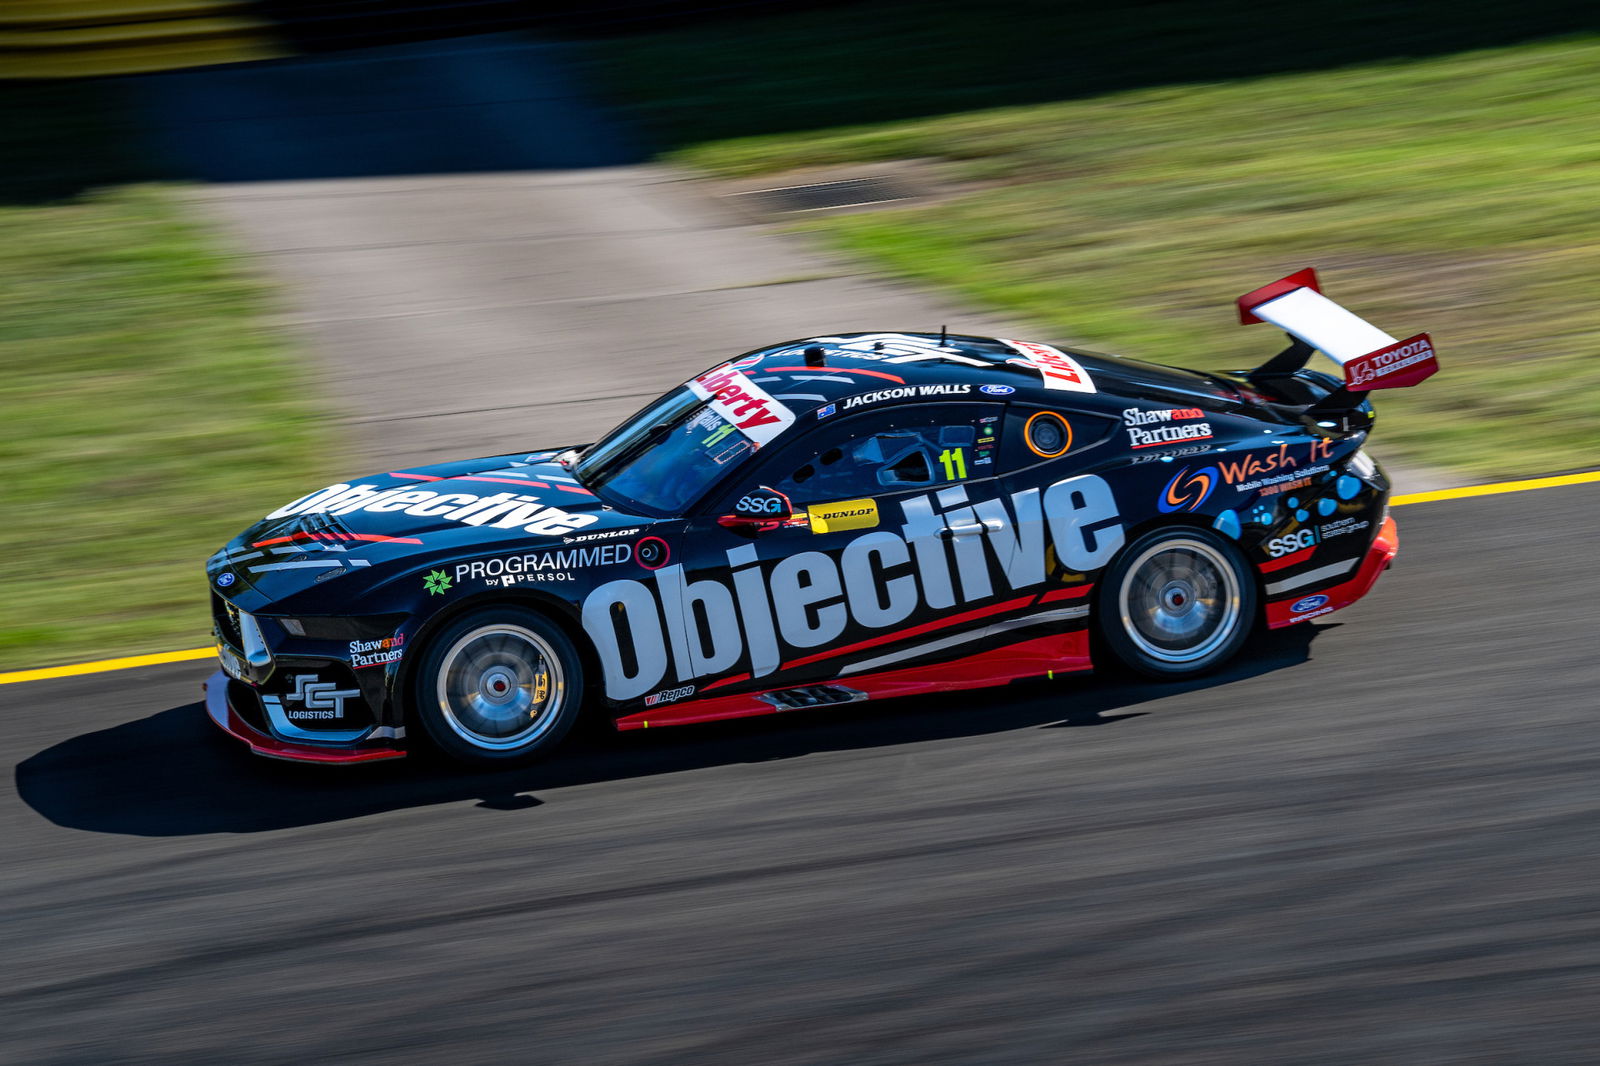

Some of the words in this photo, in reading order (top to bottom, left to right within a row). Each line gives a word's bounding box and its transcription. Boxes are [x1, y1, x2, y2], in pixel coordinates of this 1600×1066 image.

[1371, 340, 1431, 367] TOYOTA
[843, 386, 916, 410] JACKSON
[919, 384, 971, 396] WALLS
[1126, 422, 1212, 446] Partners
[939, 447, 967, 480] 11
[1218, 443, 1297, 485] Wash
[1310, 437, 1334, 463] It
[1236, 480, 1262, 492] Mobile
[1261, 473, 1295, 486] Washing
[1294, 465, 1330, 478] Solutions
[736, 495, 782, 513] SSG
[822, 508, 875, 520] DUNLOP
[574, 528, 640, 543] DUNLOP
[1268, 528, 1316, 557] SSG
[455, 543, 632, 583] PROGRAMMED
[485, 577, 499, 587] by
[517, 572, 575, 583] PERSOL
[351, 648, 402, 667] Partners
[660, 685, 695, 702] Repco
[288, 710, 334, 720] LOGISTICS
